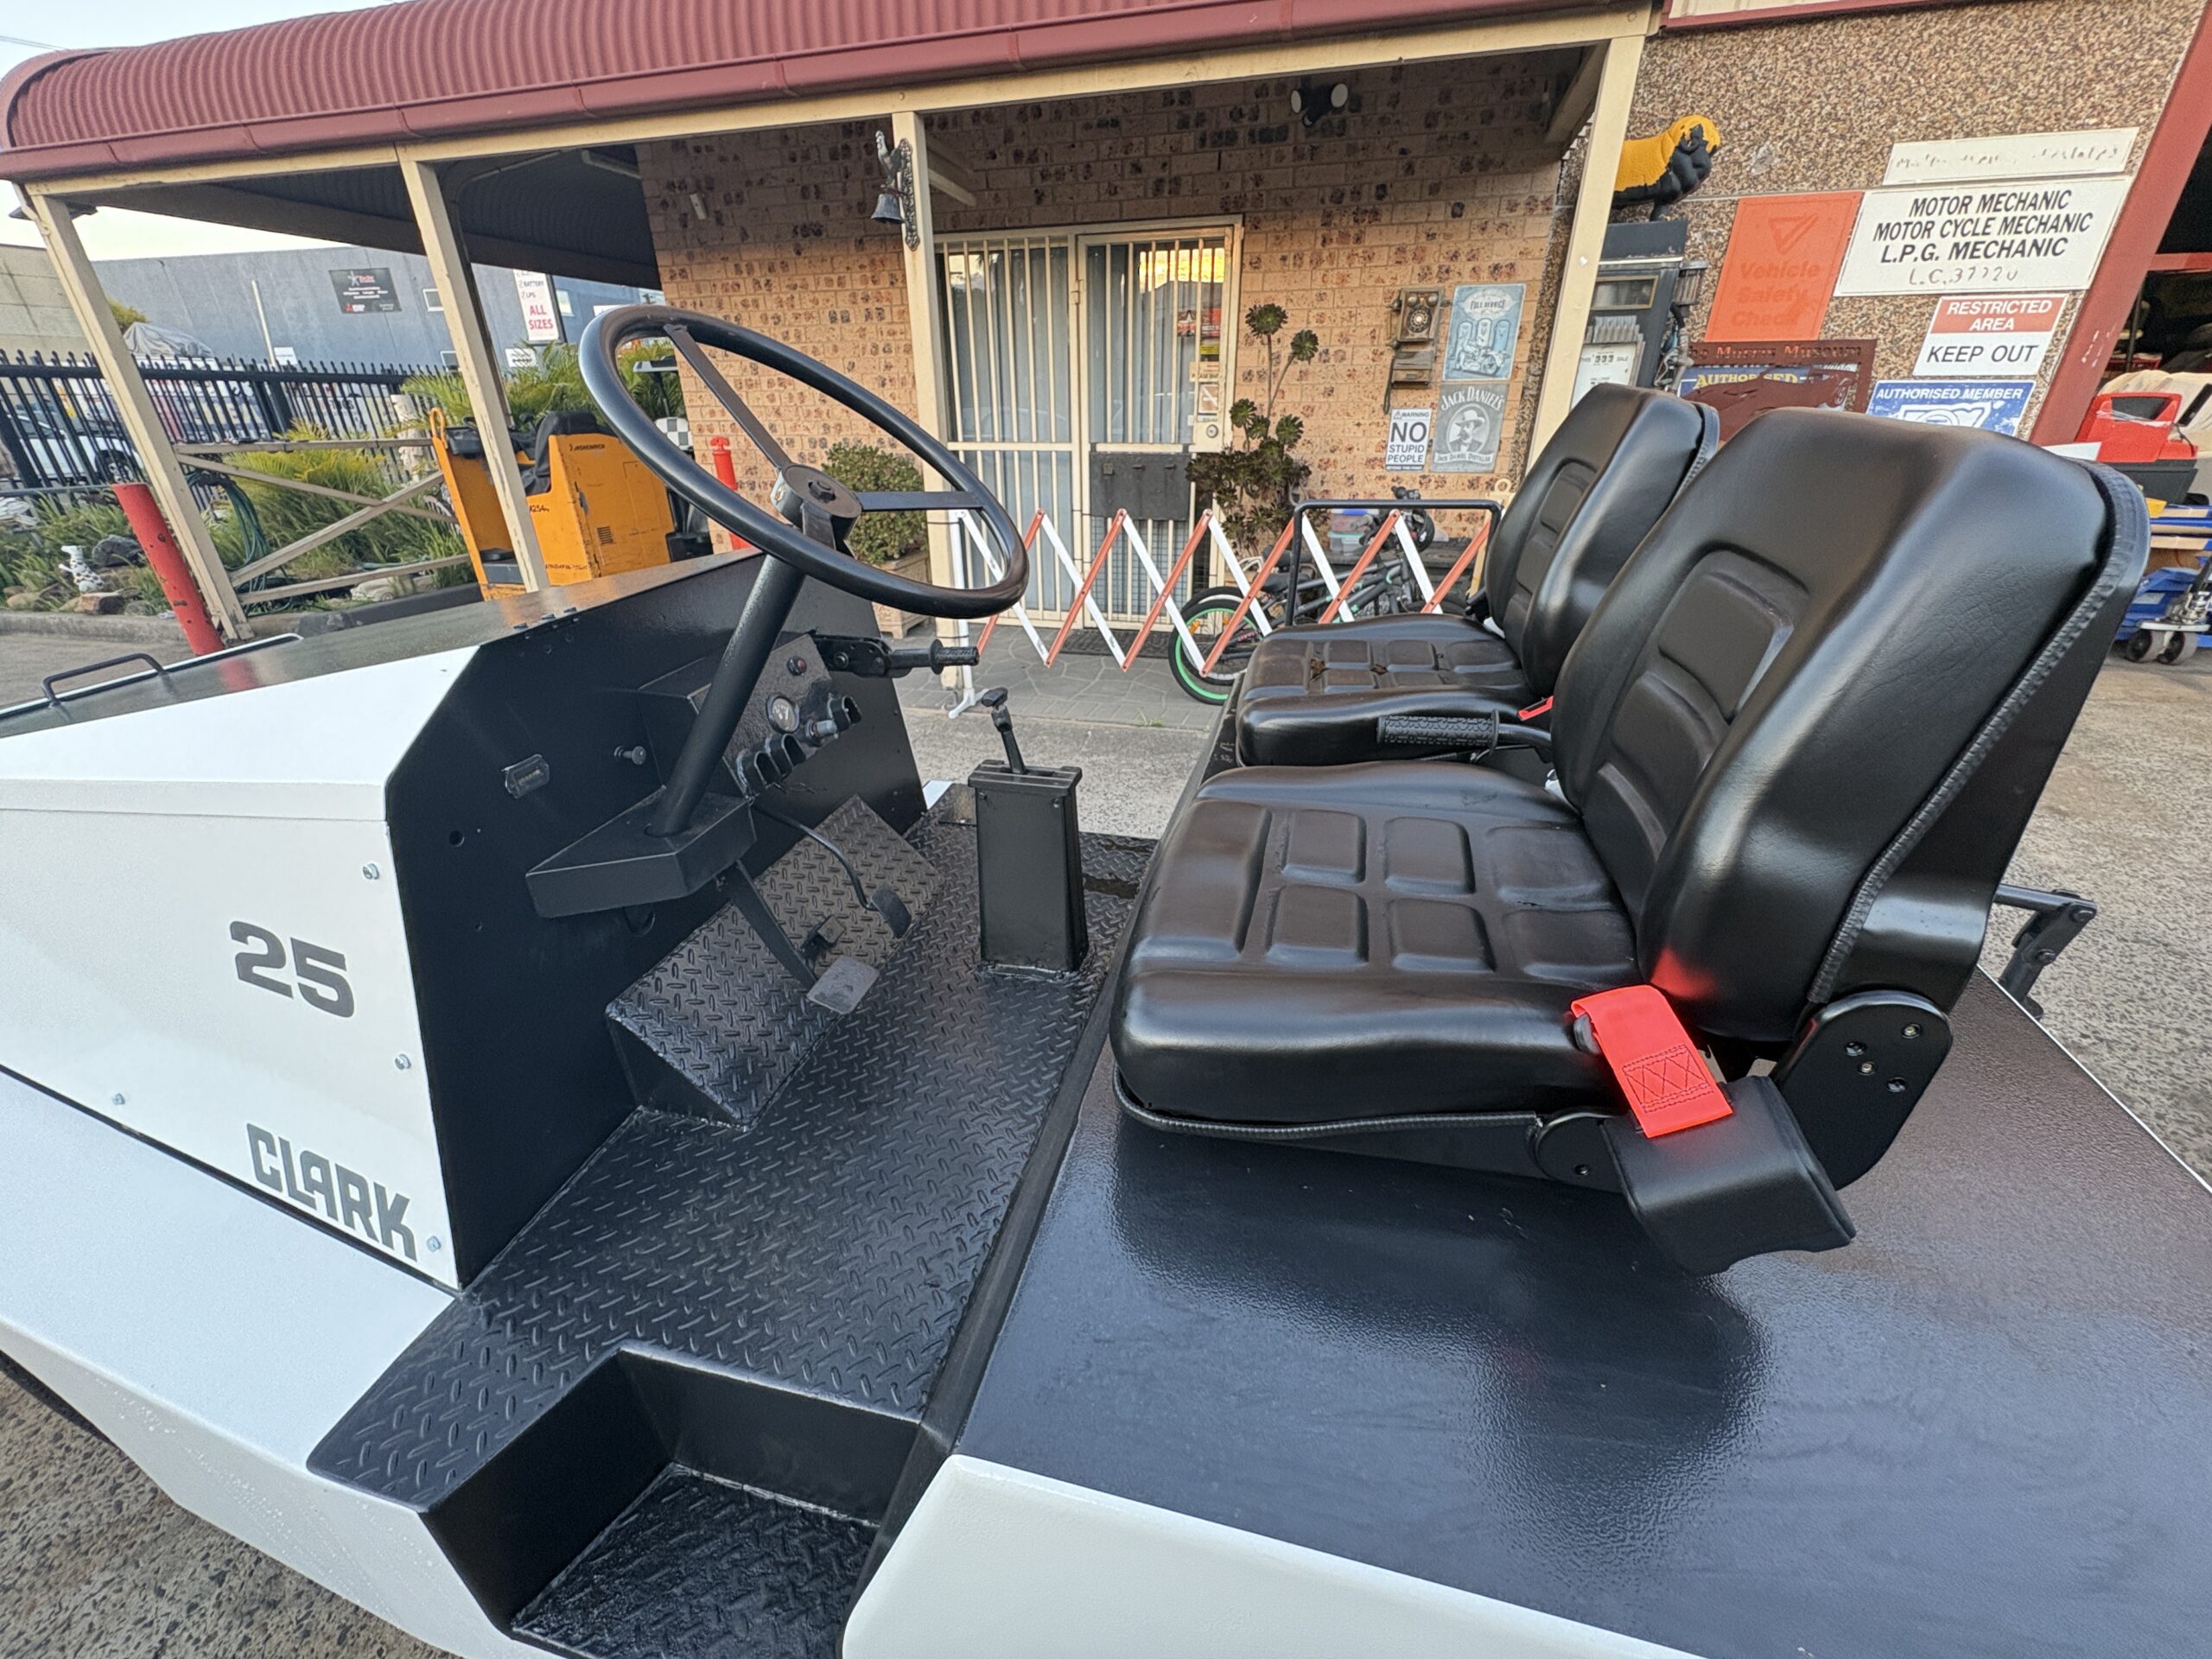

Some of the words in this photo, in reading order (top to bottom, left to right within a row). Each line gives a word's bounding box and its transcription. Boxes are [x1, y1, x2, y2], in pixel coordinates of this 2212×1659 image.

[1909, 195, 1973, 217] MOTOR
[1975, 189, 2072, 213] MECHANIC
[1872, 220, 1936, 241] MOTOR
[1940, 216, 1995, 238] CYCLE
[1998, 213, 2093, 236] MECHANIC
[1880, 244, 1939, 264] L.P.G.
[1948, 238, 2069, 260] MECHANIC
[530, 304, 546, 315] ALL
[1947, 300, 2053, 315] RESTRICTED
[529, 319, 554, 330] SIZES
[1969, 318, 2015, 331] AREA
[1926, 346, 1984, 363] KEEP
[1991, 345, 2039, 363] OUT
[1693, 373, 1799, 389] AUTHORSED
[1440, 390, 1466, 410] JACK
[1876, 389, 1961, 400] AUTHORISED
[1962, 388, 2024, 400] MEMBER
[1390, 422, 1427, 443] NO
[1389, 444, 1425, 454] STUPID
[1388, 454, 1424, 463] PEOPLE
[229, 920, 355, 1018] 25
[246, 1123, 417, 1262] CLARK
